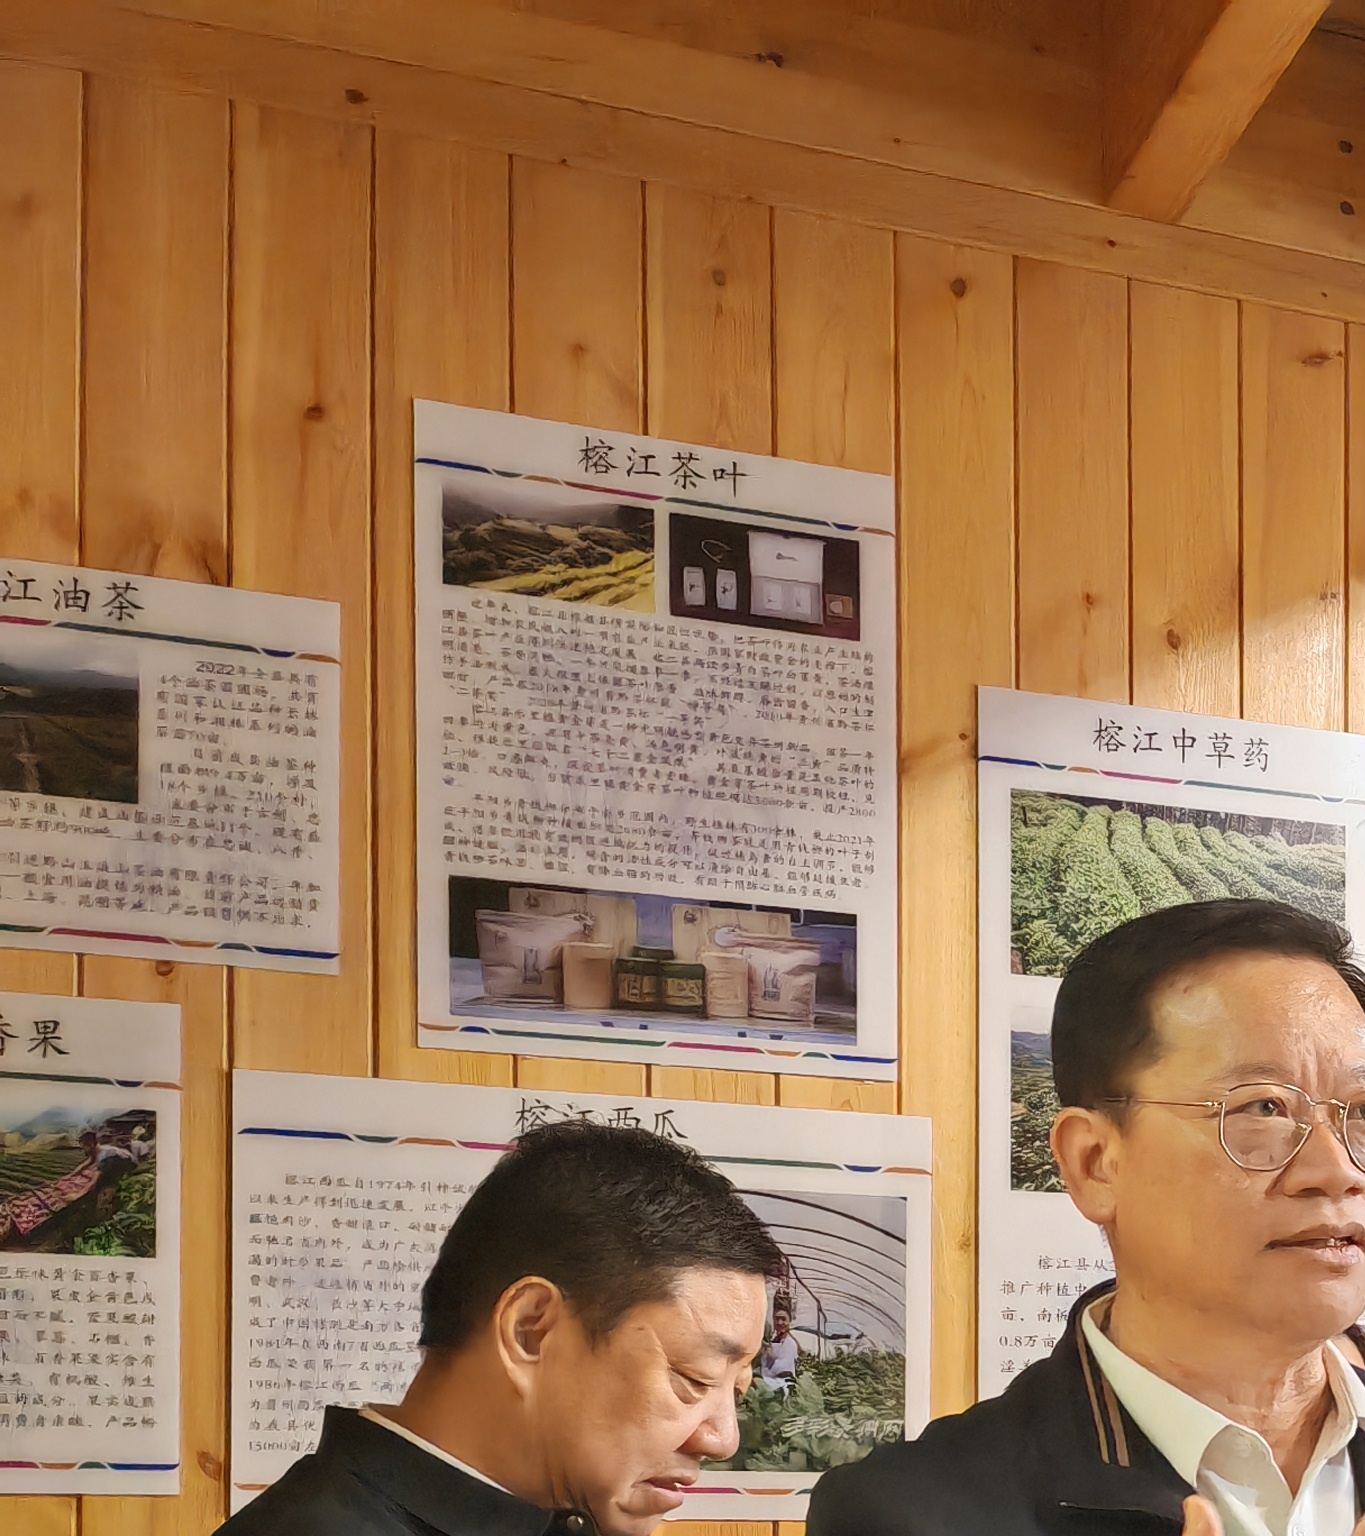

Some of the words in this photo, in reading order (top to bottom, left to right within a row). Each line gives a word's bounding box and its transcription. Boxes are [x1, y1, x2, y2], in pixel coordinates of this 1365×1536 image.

[577, 436, 750, 499] 榕江茶叶
[0, 570, 146, 622] 江油茶
[1092, 715, 1271, 773] 榕江中草药
[1000, 1280, 1087, 1297] 推广种植中
